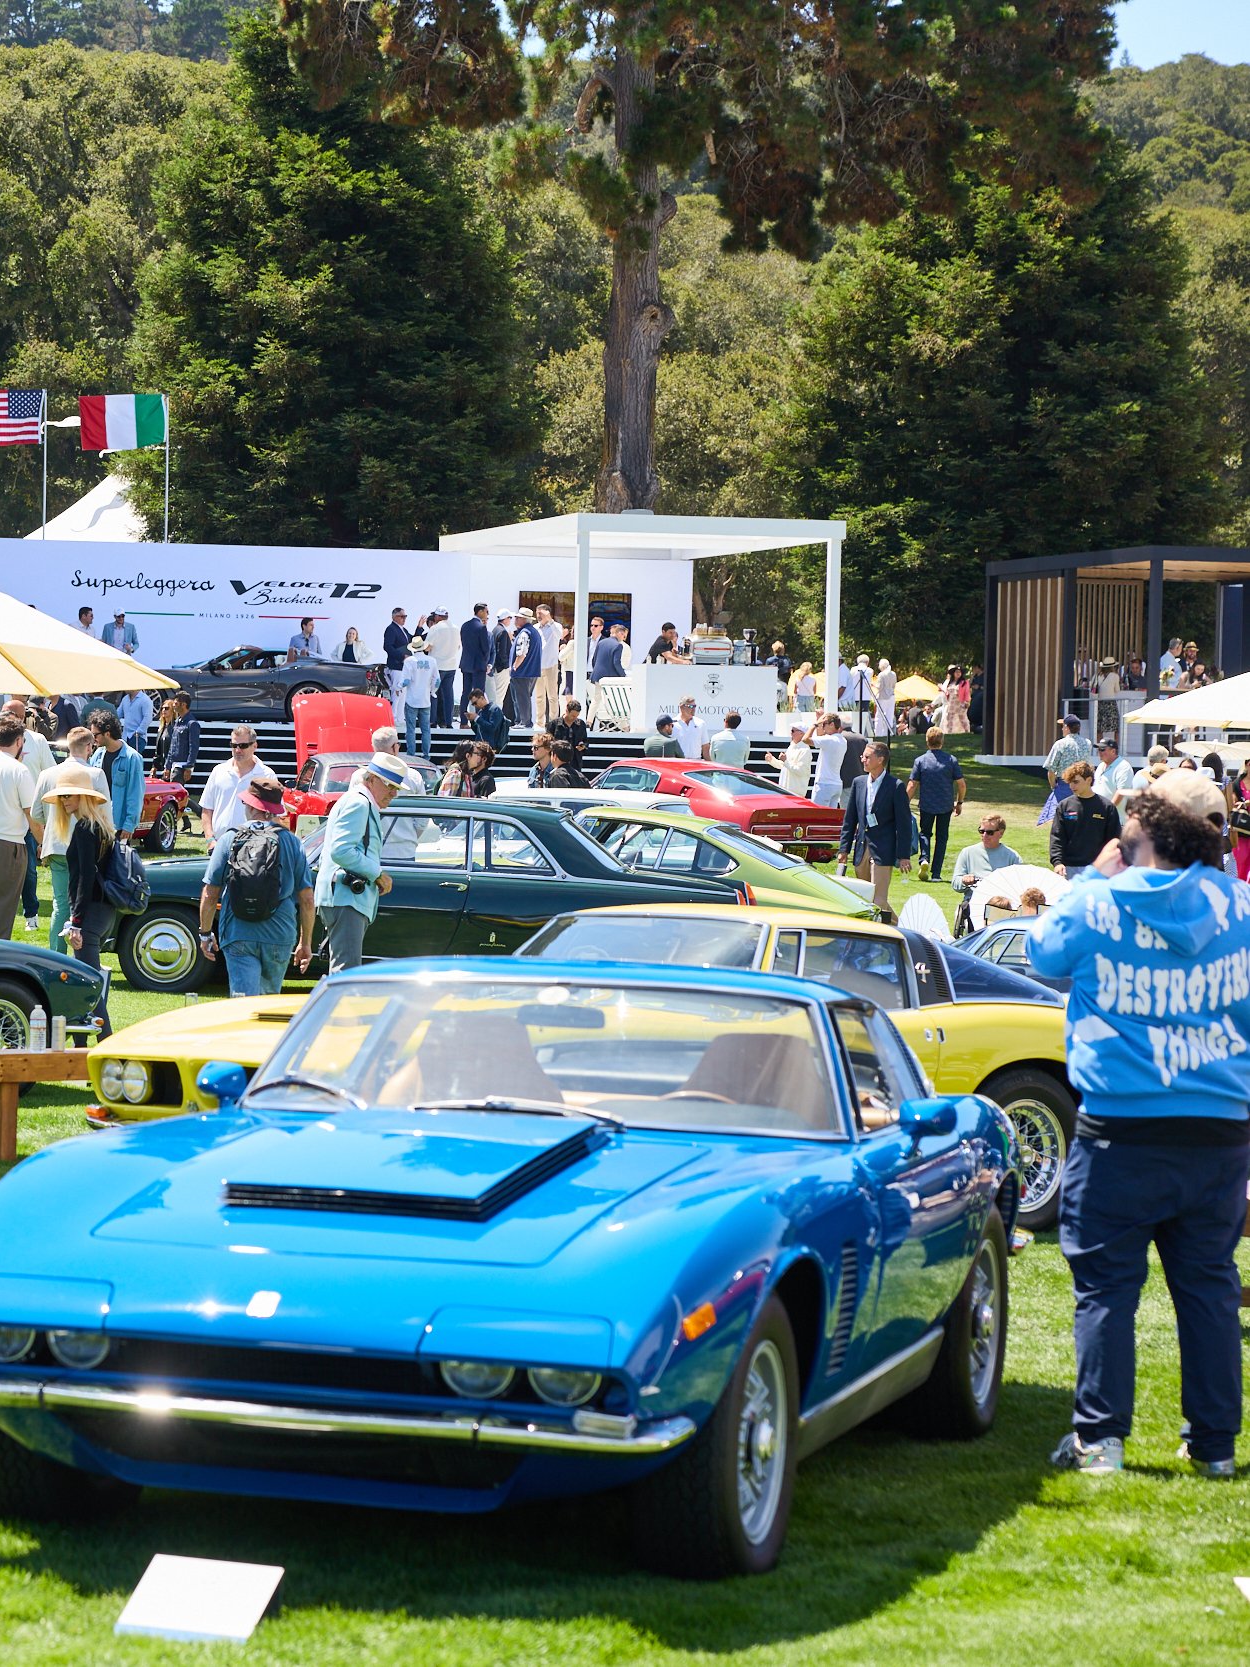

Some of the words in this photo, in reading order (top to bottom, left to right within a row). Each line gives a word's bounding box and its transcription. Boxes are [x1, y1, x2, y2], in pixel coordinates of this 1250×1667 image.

[71, 570, 215, 597] Superleggera
[244, 588, 324, 605] Barchetta
[1095, 947, 1250, 1018] DESTROYIN
